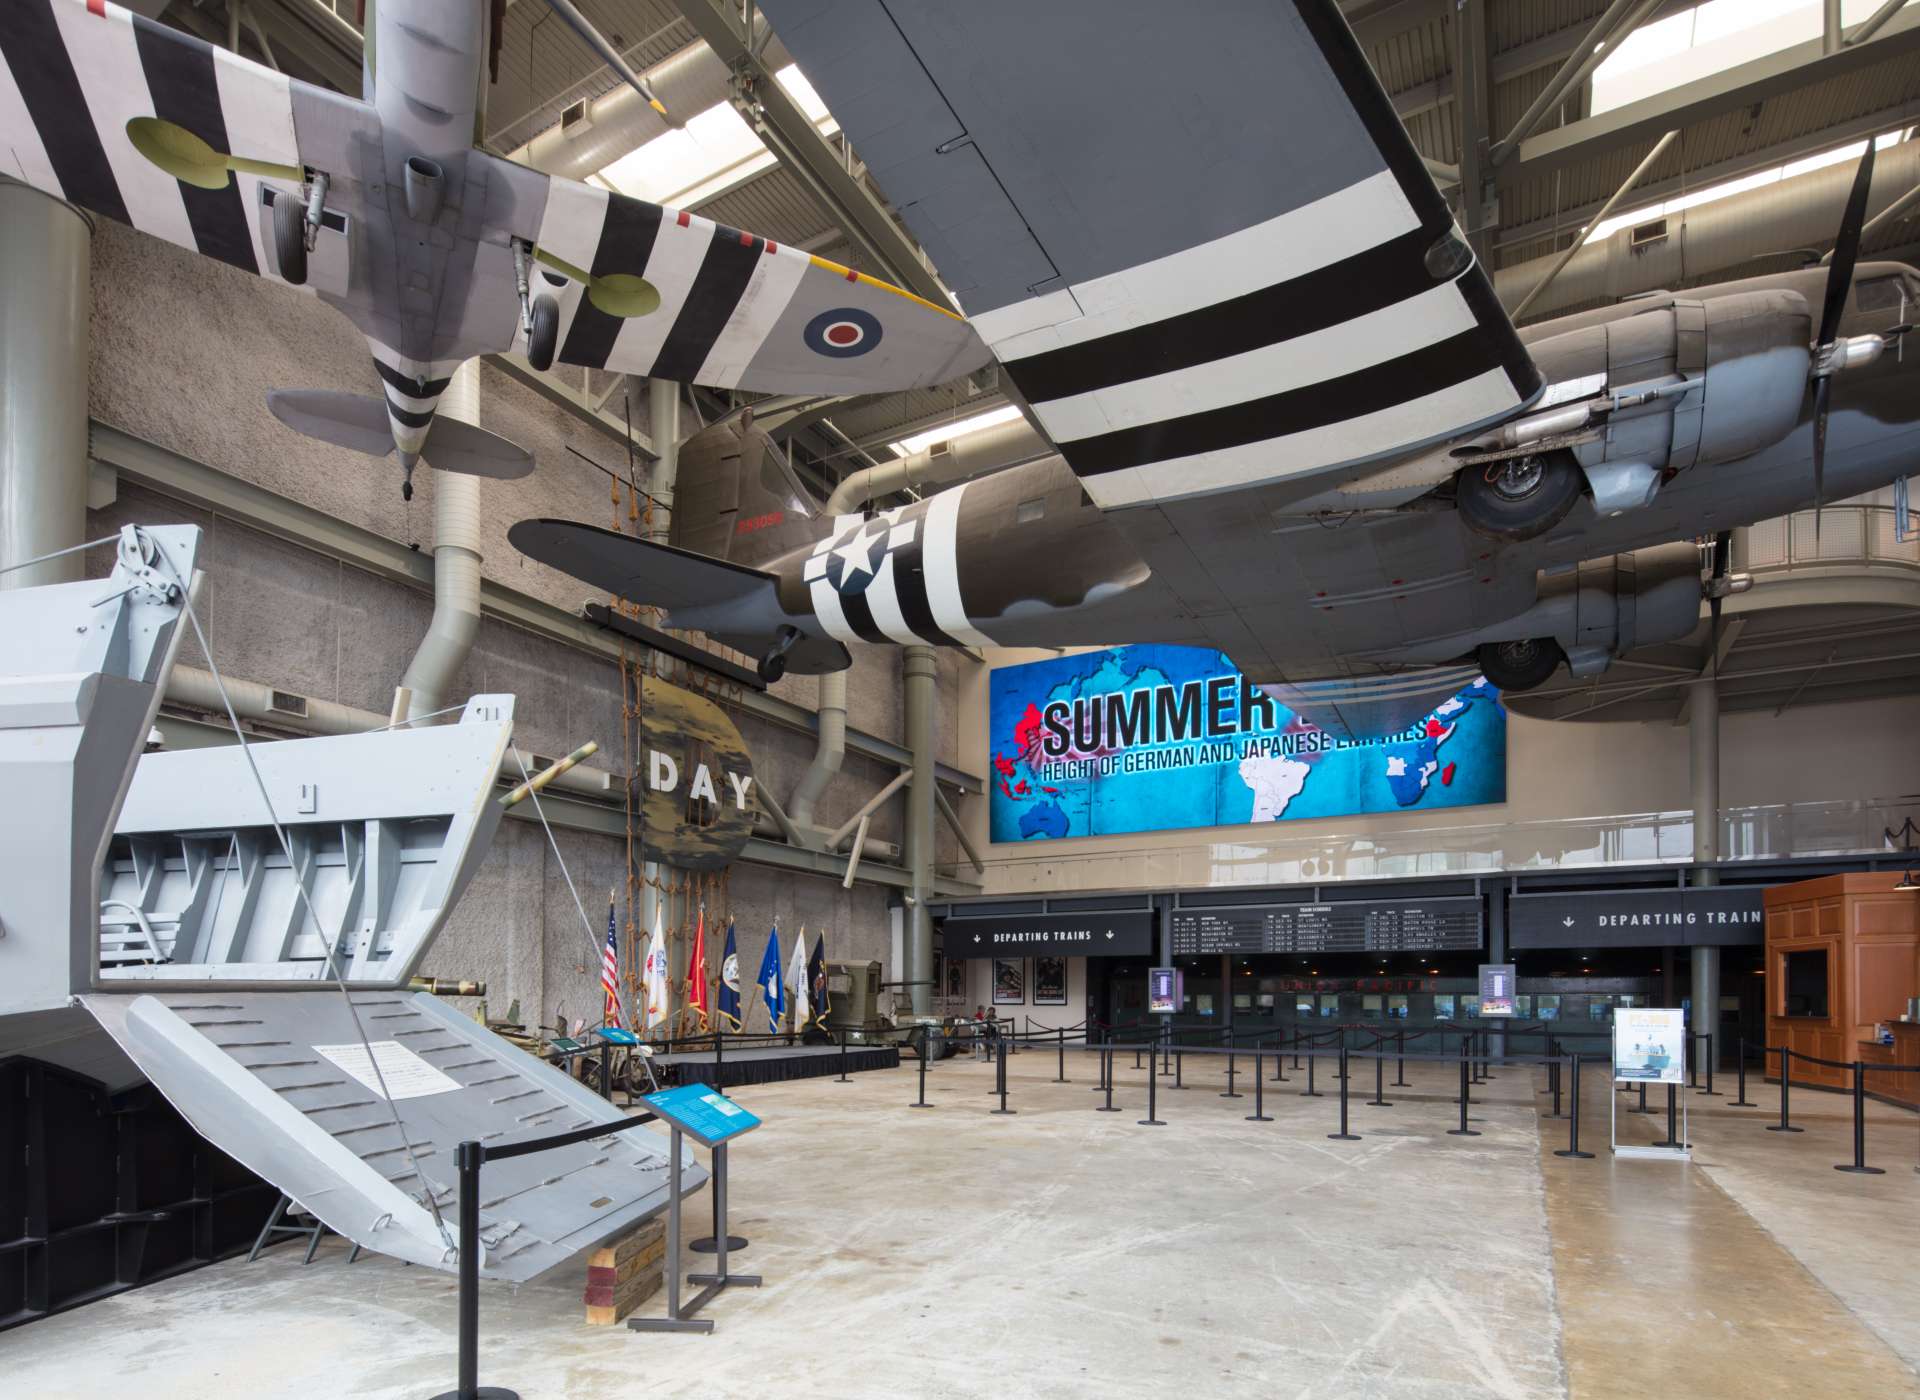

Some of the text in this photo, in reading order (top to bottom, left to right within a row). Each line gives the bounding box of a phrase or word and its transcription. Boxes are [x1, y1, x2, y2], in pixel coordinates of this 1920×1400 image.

[1043, 675, 1275, 756] SUMMER
[650, 749, 752, 810] DAY
[1043, 758, 1096, 781] HEIGHT
[1101, 755, 1121, 775] OF
[1124, 746, 1194, 773] GERMAN
[1200, 742, 1234, 765] AND
[1239, 731, 1331, 760] JAPANESE
[994, 930, 1091, 942] DEPARTING TRAINS
[1599, 911, 1761, 926] DEPARTING TRAIN
